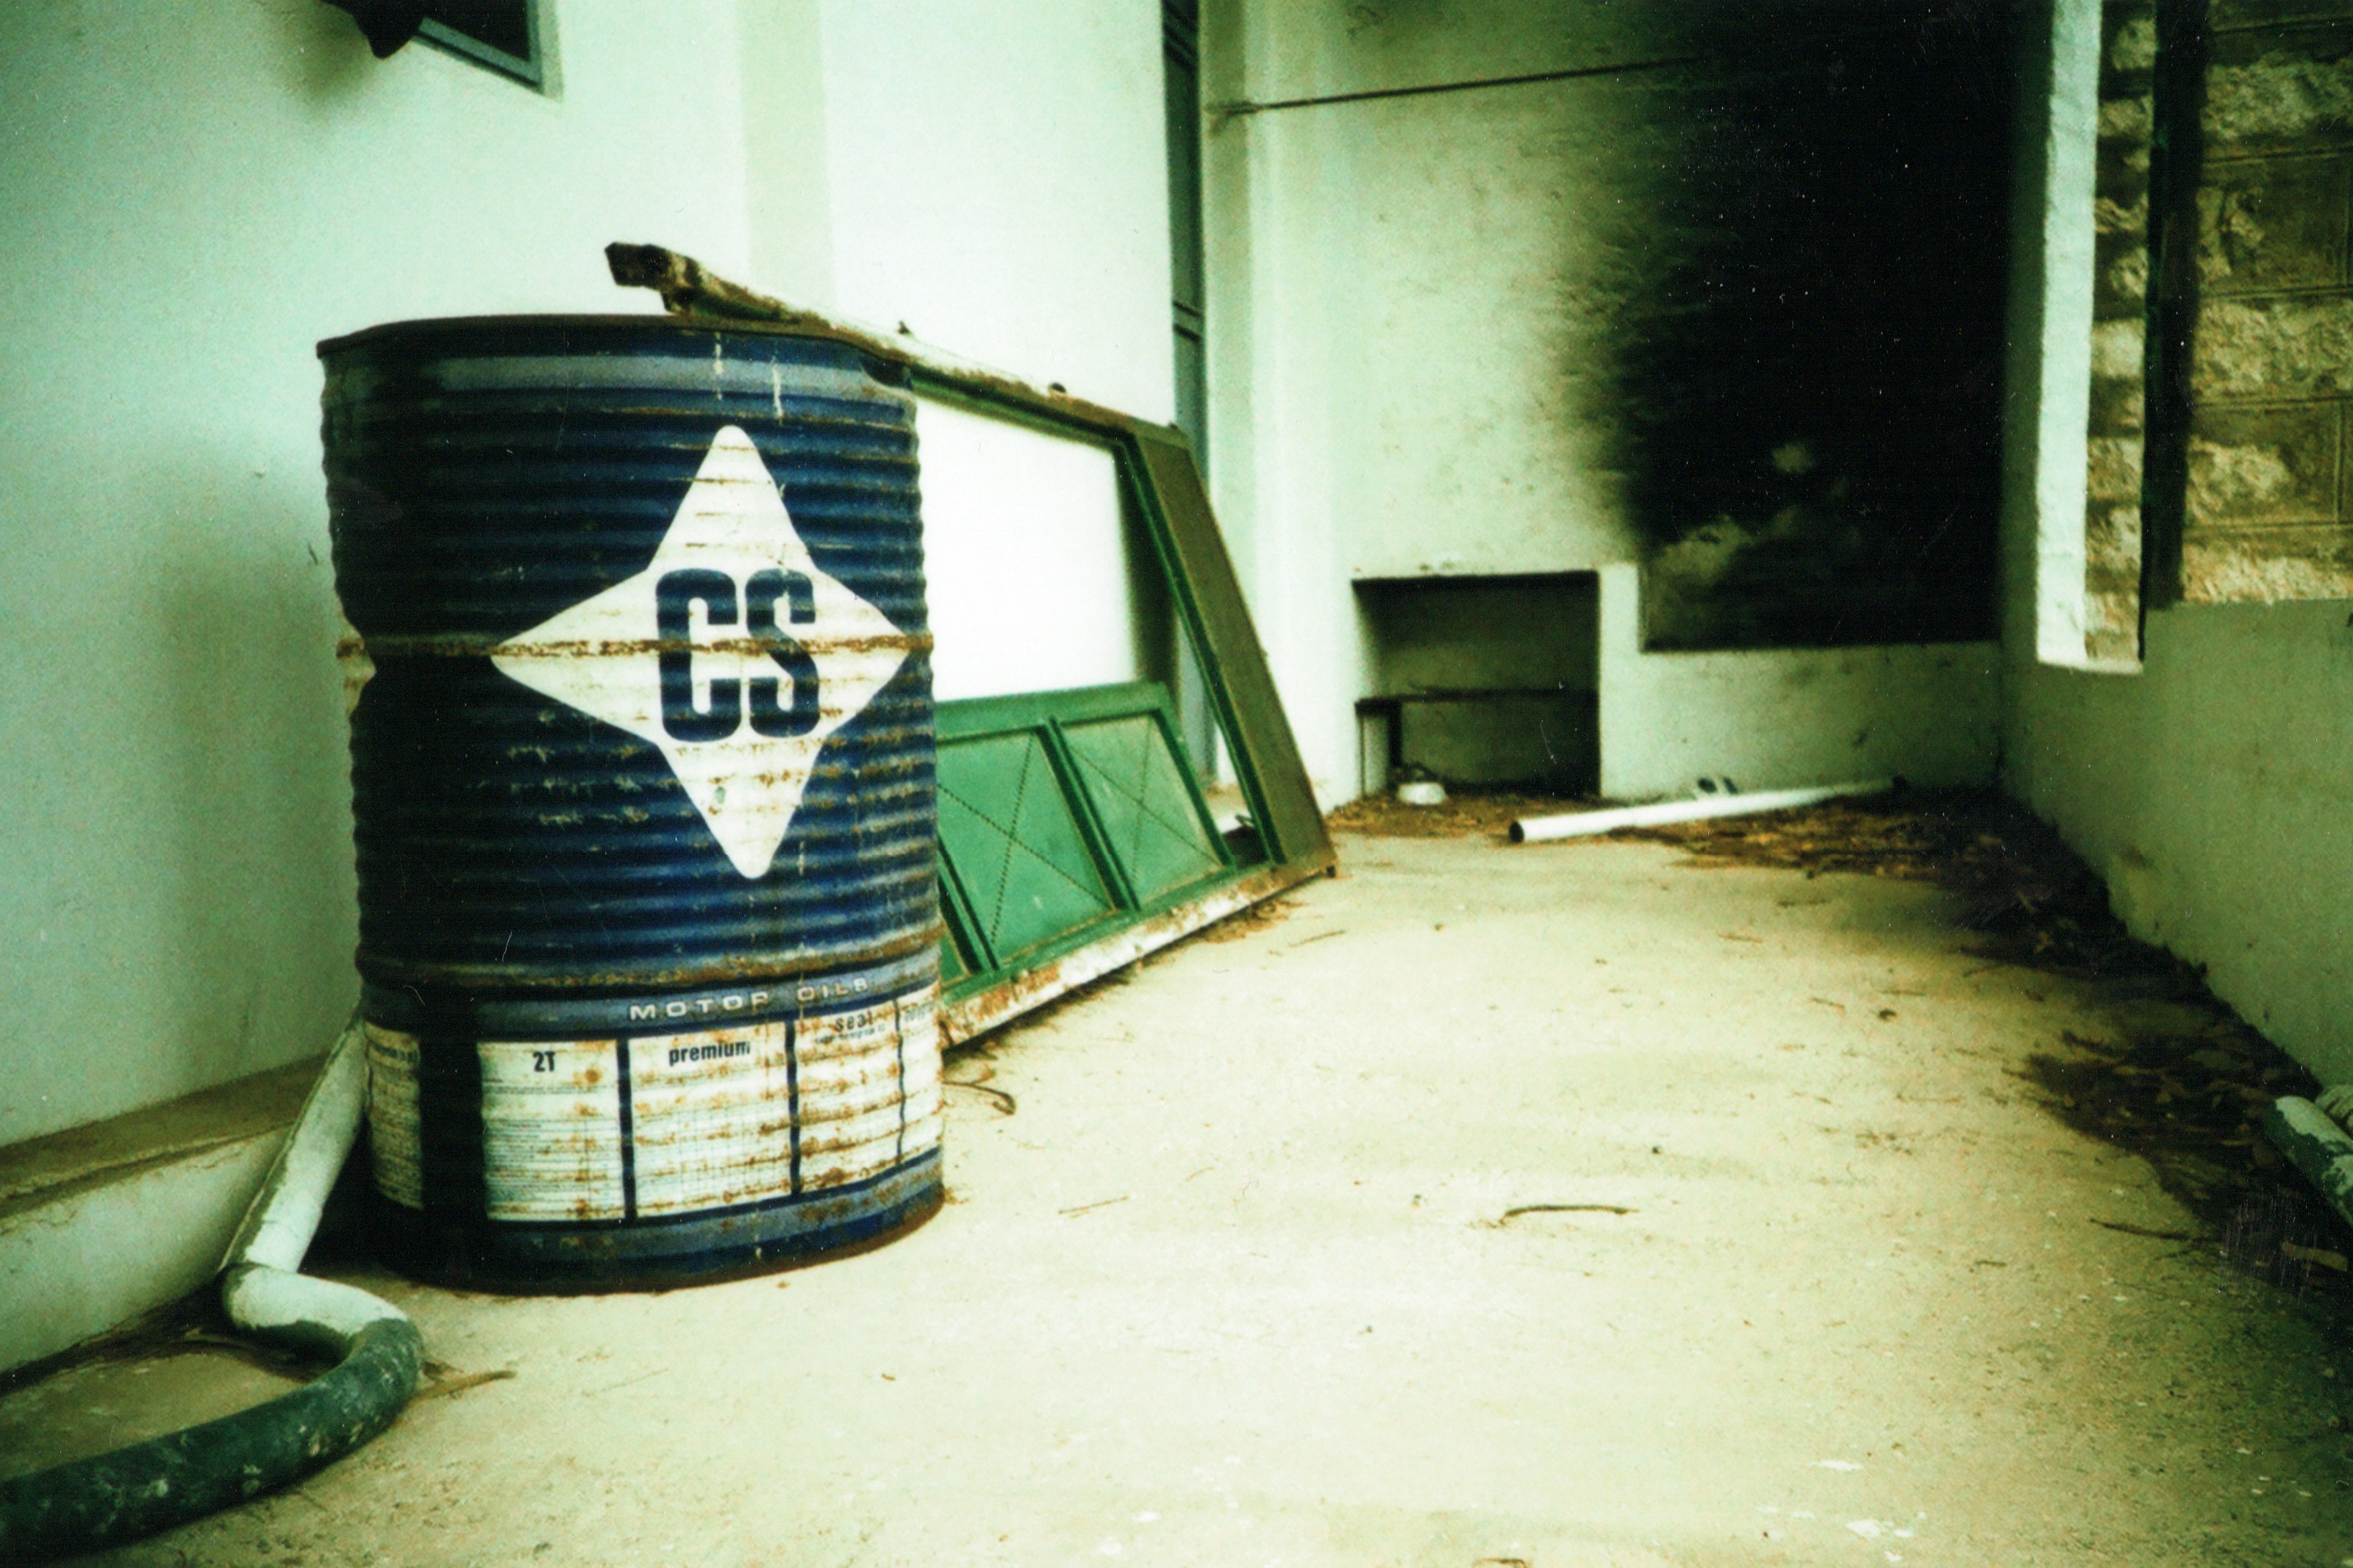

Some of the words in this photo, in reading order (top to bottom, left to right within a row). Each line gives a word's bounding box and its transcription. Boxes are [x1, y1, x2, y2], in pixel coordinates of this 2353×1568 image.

[654, 568, 820, 742] CS
[630, 991, 769, 1020] MOTOR
[797, 978, 868, 1002] OILS
[532, 1050, 556, 1073] 2T
[668, 1040, 751, 1067] premium
